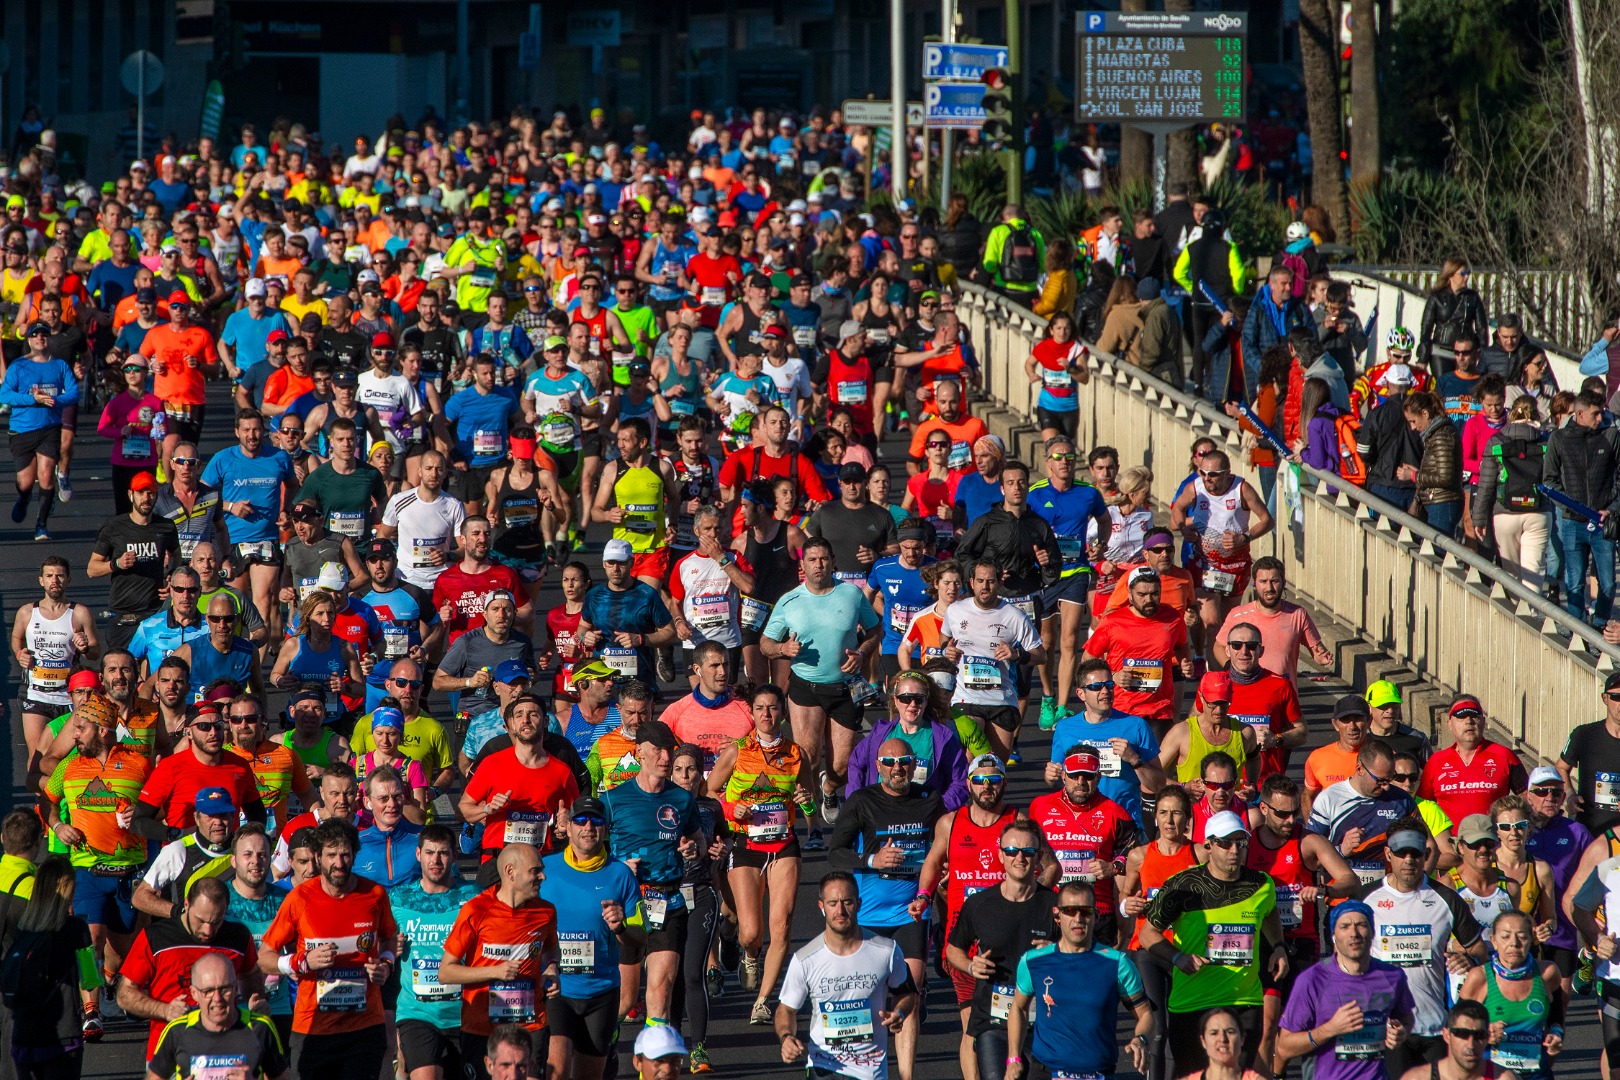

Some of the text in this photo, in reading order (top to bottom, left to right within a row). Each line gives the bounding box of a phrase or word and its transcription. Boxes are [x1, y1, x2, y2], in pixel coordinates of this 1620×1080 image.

[1089, 14, 1101, 29] P
[1118, 14, 1159, 22] Ayuntamiento
[1097, 37, 1241, 51] PLAZA CUBA 118
[927, 47, 942, 75] P
[1097, 53, 1241, 67] MARISTAS 92
[1096, 69, 1241, 83] BUENOS AIRES 100
[1096, 86, 1241, 100] VIRGEN LUJAN 114
[927, 86, 942, 115] P
[954, 106, 986, 116] CUBA
[1134, 101, 1163, 116] SAN
[1169, 101, 1204, 116] JOSE
[1222, 101, 1241, 116] 25
[233, 478, 248, 486] XVI
[456, 599, 482, 607] VINYA
[458, 605, 484, 613] CROSS
[1440, 781, 1498, 792] Los Lentos
[887, 822, 924, 836] MENTON
[1047, 831, 1103, 843] Los Lentos
[955, 870, 1007, 880] Los Lento
[1276, 882, 1304, 892] entos
[561, 932, 589, 940] ZURICH
[1397, 927, 1426, 935] ZURICH
[1395, 942, 1419, 950] 10462
[484, 946, 511, 957] BILBAO
[425, 975, 439, 983] 122
[334, 986, 353, 994] 9236
[506, 997, 524, 1005] 6903
[835, 1002, 864, 1011] ZURICH
[834, 1016, 858, 1025] 12372
[1510, 1033, 1537, 1042] ZURICH
